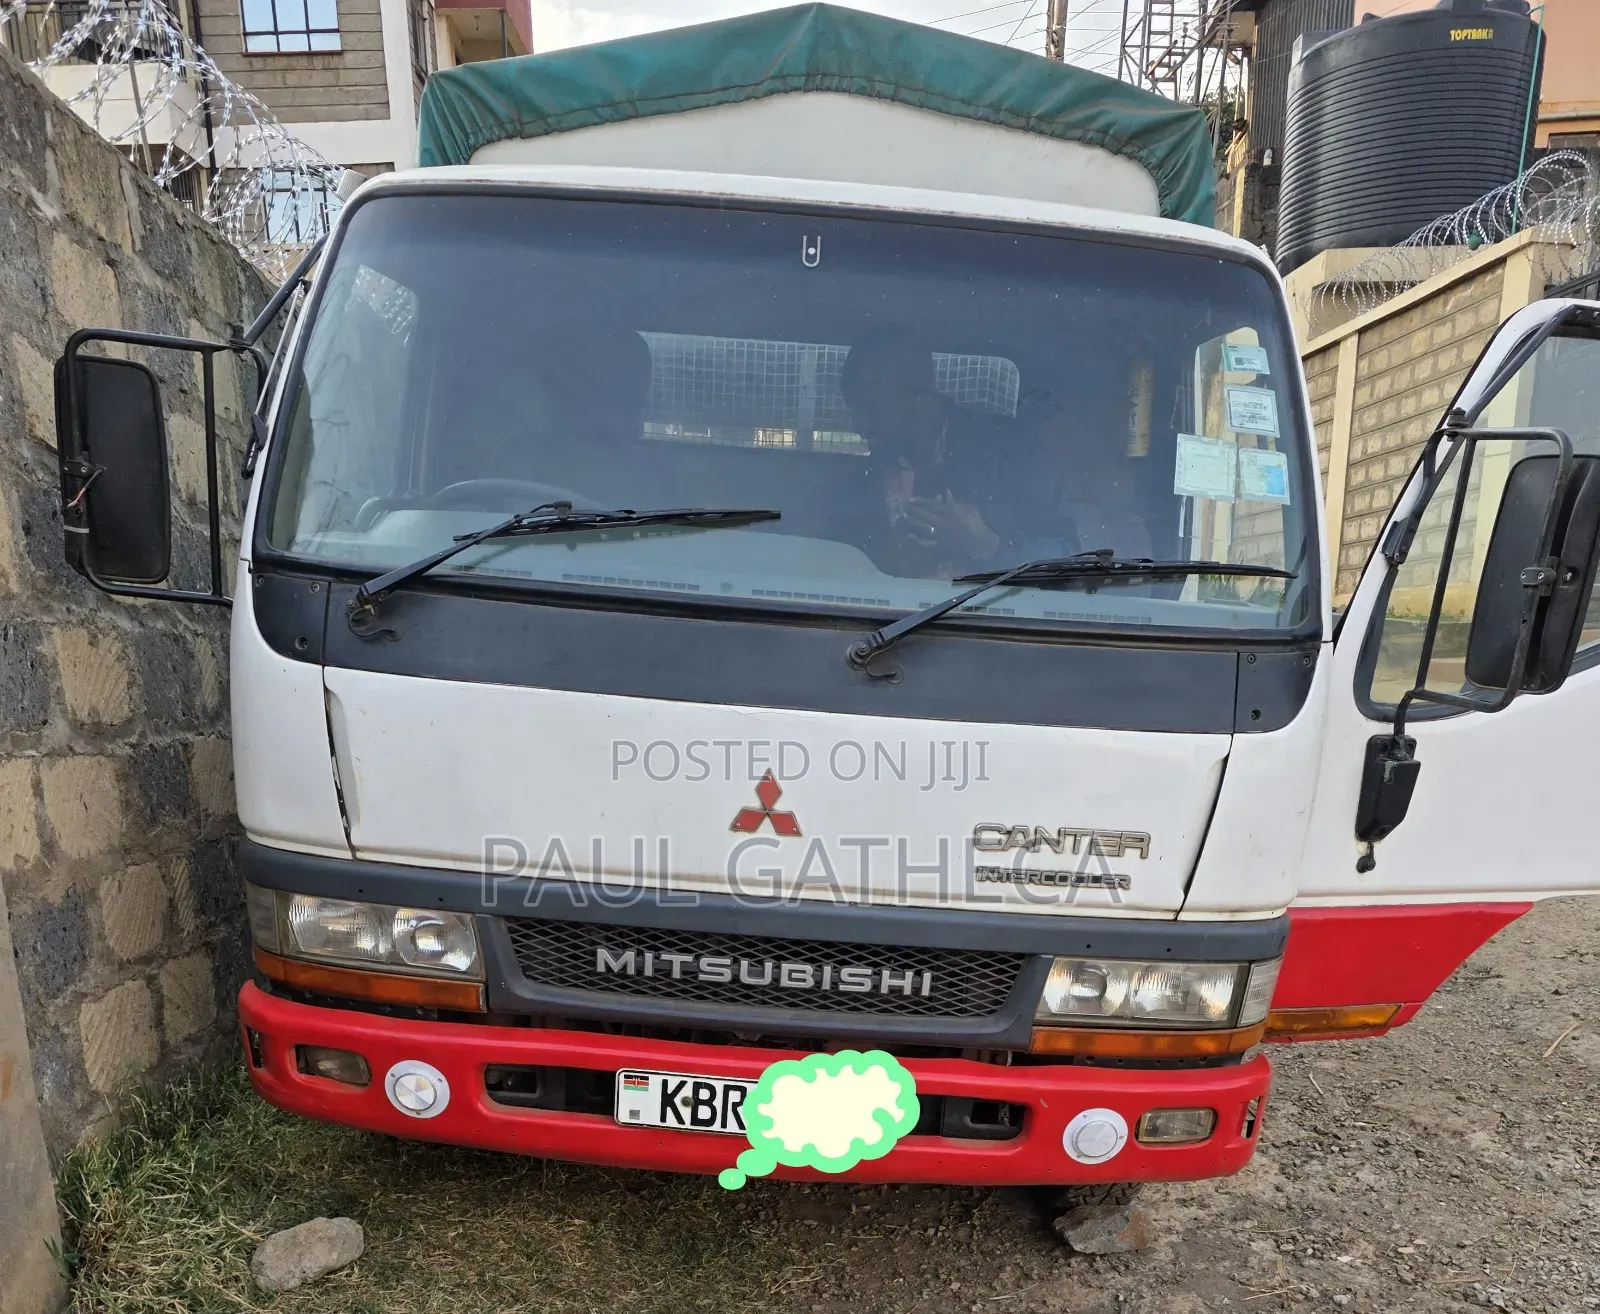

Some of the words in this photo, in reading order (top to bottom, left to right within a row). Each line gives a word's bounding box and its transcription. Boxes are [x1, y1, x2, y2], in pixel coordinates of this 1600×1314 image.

[1450, 28, 1488, 41] TOPTANK
[974, 823, 1151, 859] CANTER
[976, 866, 1132, 890] INTERCOOLER
[597, 948, 933, 998] MITSUBISHI
[660, 1079, 748, 1130] KBR
